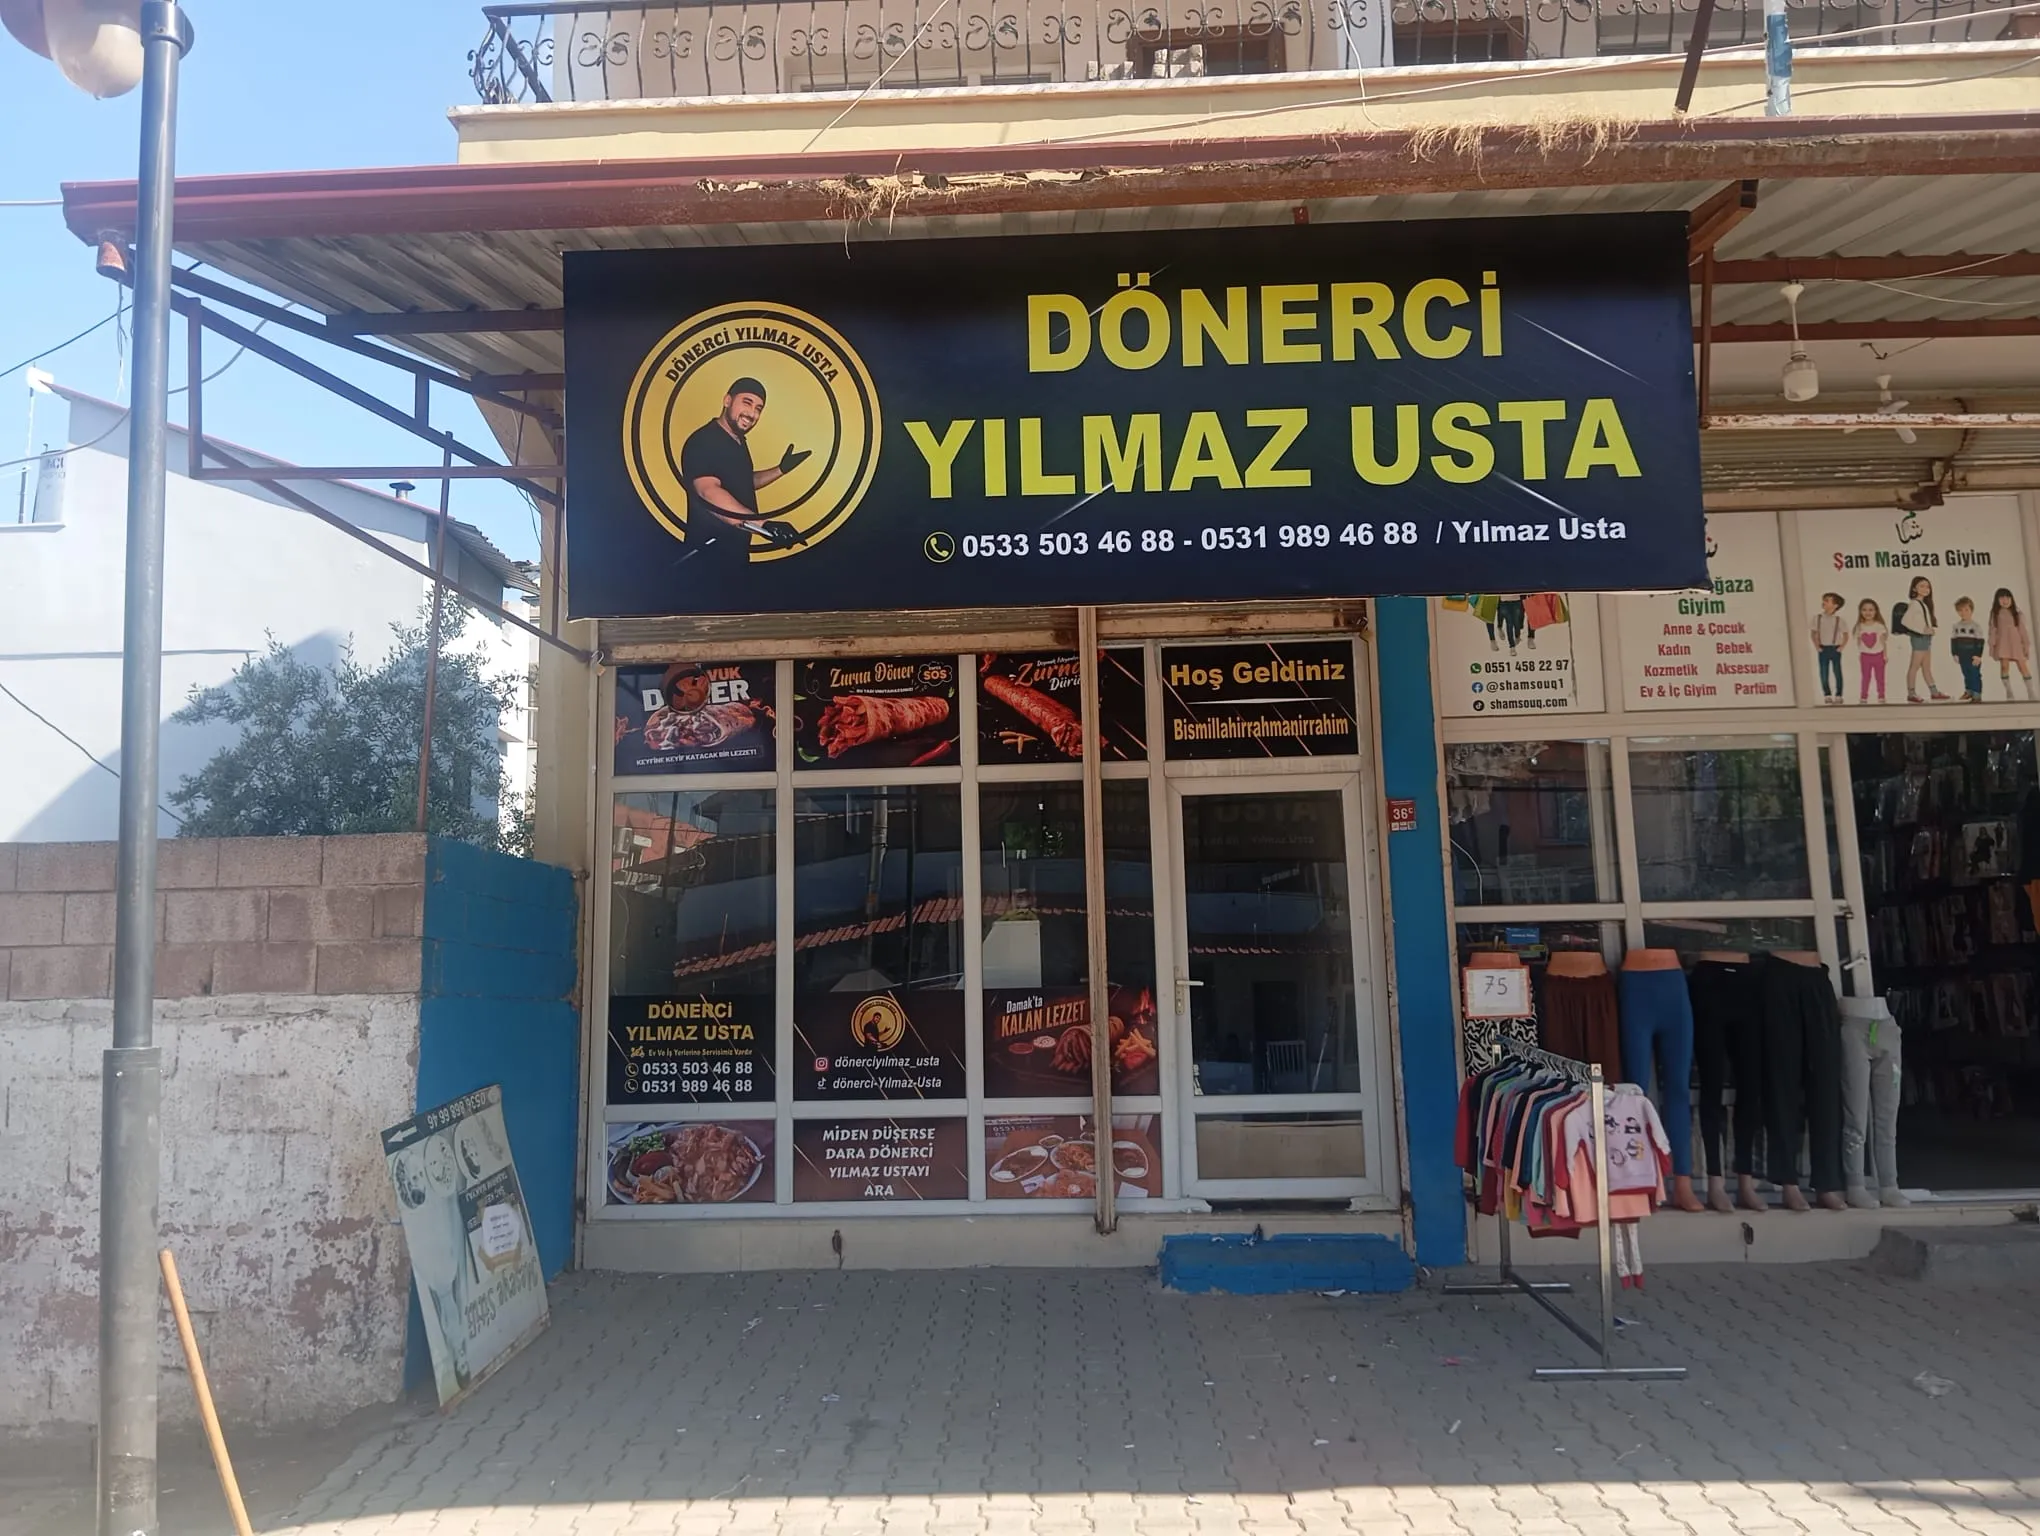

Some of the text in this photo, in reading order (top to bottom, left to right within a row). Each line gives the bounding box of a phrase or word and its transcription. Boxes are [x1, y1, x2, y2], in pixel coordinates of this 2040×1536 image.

[1027, 270, 1503, 374] DÖNERCİ
[665, 326, 839, 383] DÖNERCİ YILMAZ USTA
[903, 397, 1643, 499] YILMAZ USTA
[962, 533, 1029, 557] 0533
[1039, 532, 1089, 556] 503
[1098, 530, 1132, 553] 46
[1141, 529, 1175, 551] 88
[1201, 526, 1266, 550] 0531
[1279, 524, 1331, 548] 989
[1339, 523, 1374, 546] 46
[1383, 521, 1418, 544] 88
[1452, 519, 1550, 543] Yılmaz
[1559, 517, 1627, 540] Usta
[1833, 548, 1991, 572] Şam Mağaza Giyim
[1678, 598, 1726, 616] Giyim
[1663, 622, 1746, 637] Anne & Çocuk
[1658, 643, 1691, 656] Kadın
[1716, 642, 1753, 654] Bebek
[706, 666, 742, 681] VUK
[874, 662, 914, 683] Döner
[1485, 659, 1569, 673] 0551 458 22 97
[1644, 663, 1699, 677] Kozmetik
[1716, 662, 1770, 675] Aksesuar
[923, 669, 948, 681] SOS
[1171, 659, 1346, 691] Hoş Geldiniz
[1486, 678, 1564, 693] @shamsouq1
[1640, 682, 1717, 698] Ev & İç Giyim
[1734, 682, 1777, 695] Parfüm
[642, 679, 751, 712] DER
[1490, 698, 1568, 709] shamsouq.com
[1174, 713, 1349, 741] Bismillahirrahmanirrahim
[685, 752, 718, 762] KATACAK
[1484, 975, 1508, 996] 75
[648, 1001, 733, 1019] DÖNERCİ
[1006, 995, 1043, 1014] Damak'ta
[1001, 1000, 1086, 1038] KALAN LEZZET
[626, 1024, 755, 1041] YILMAZ USTA
[642, 1061, 753, 1075] 0533 503 46 88
[641, 1079, 753, 1093] 0531 989 46 88
[427, 1112, 439, 1129] 46
[822, 1125, 936, 1144] MİDEN DÜŞERSE
[825, 1142, 934, 1160] DARA DÖNERCİ
[829, 1165, 930, 1179] YILMAZ USTAYI
[864, 1184, 894, 1197] ARA
